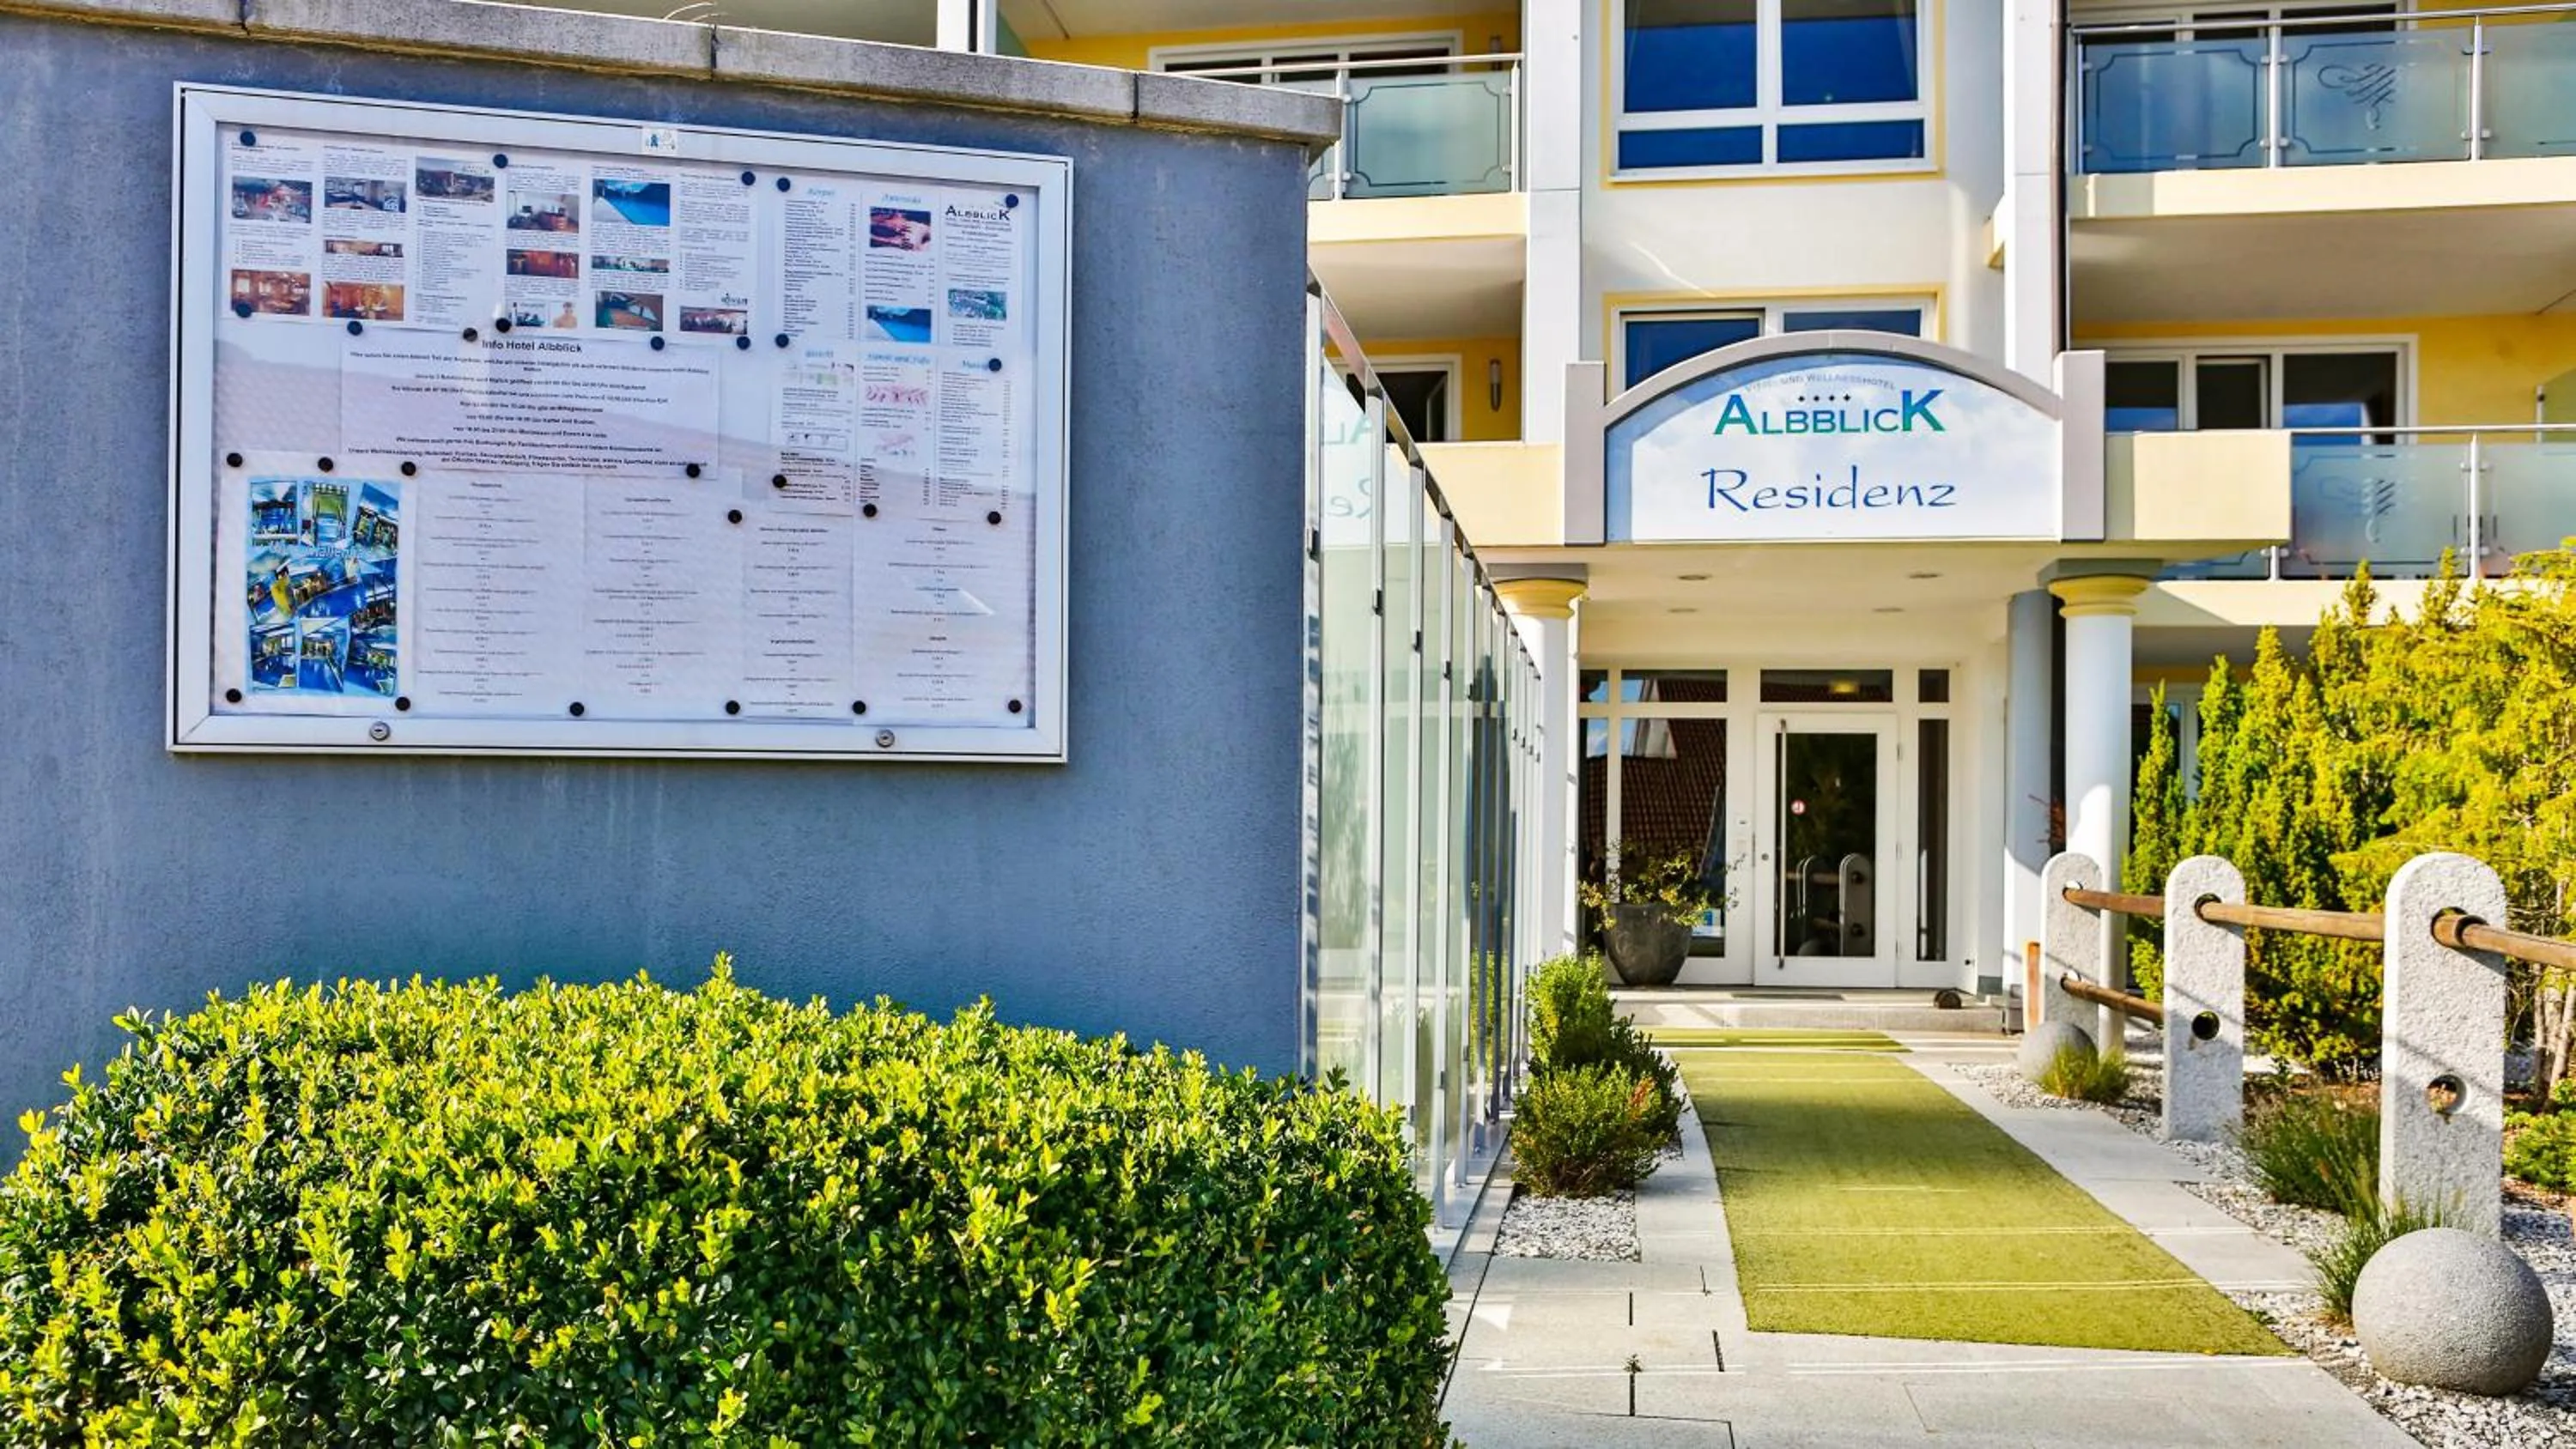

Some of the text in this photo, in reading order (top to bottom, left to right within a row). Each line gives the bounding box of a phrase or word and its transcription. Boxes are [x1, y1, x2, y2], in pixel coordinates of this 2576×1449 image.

[482, 340, 583, 353] Info Hotel Albblick
[1714, 390, 1946, 435] ALBBLICK
[1700, 464, 1957, 512] Residenz
